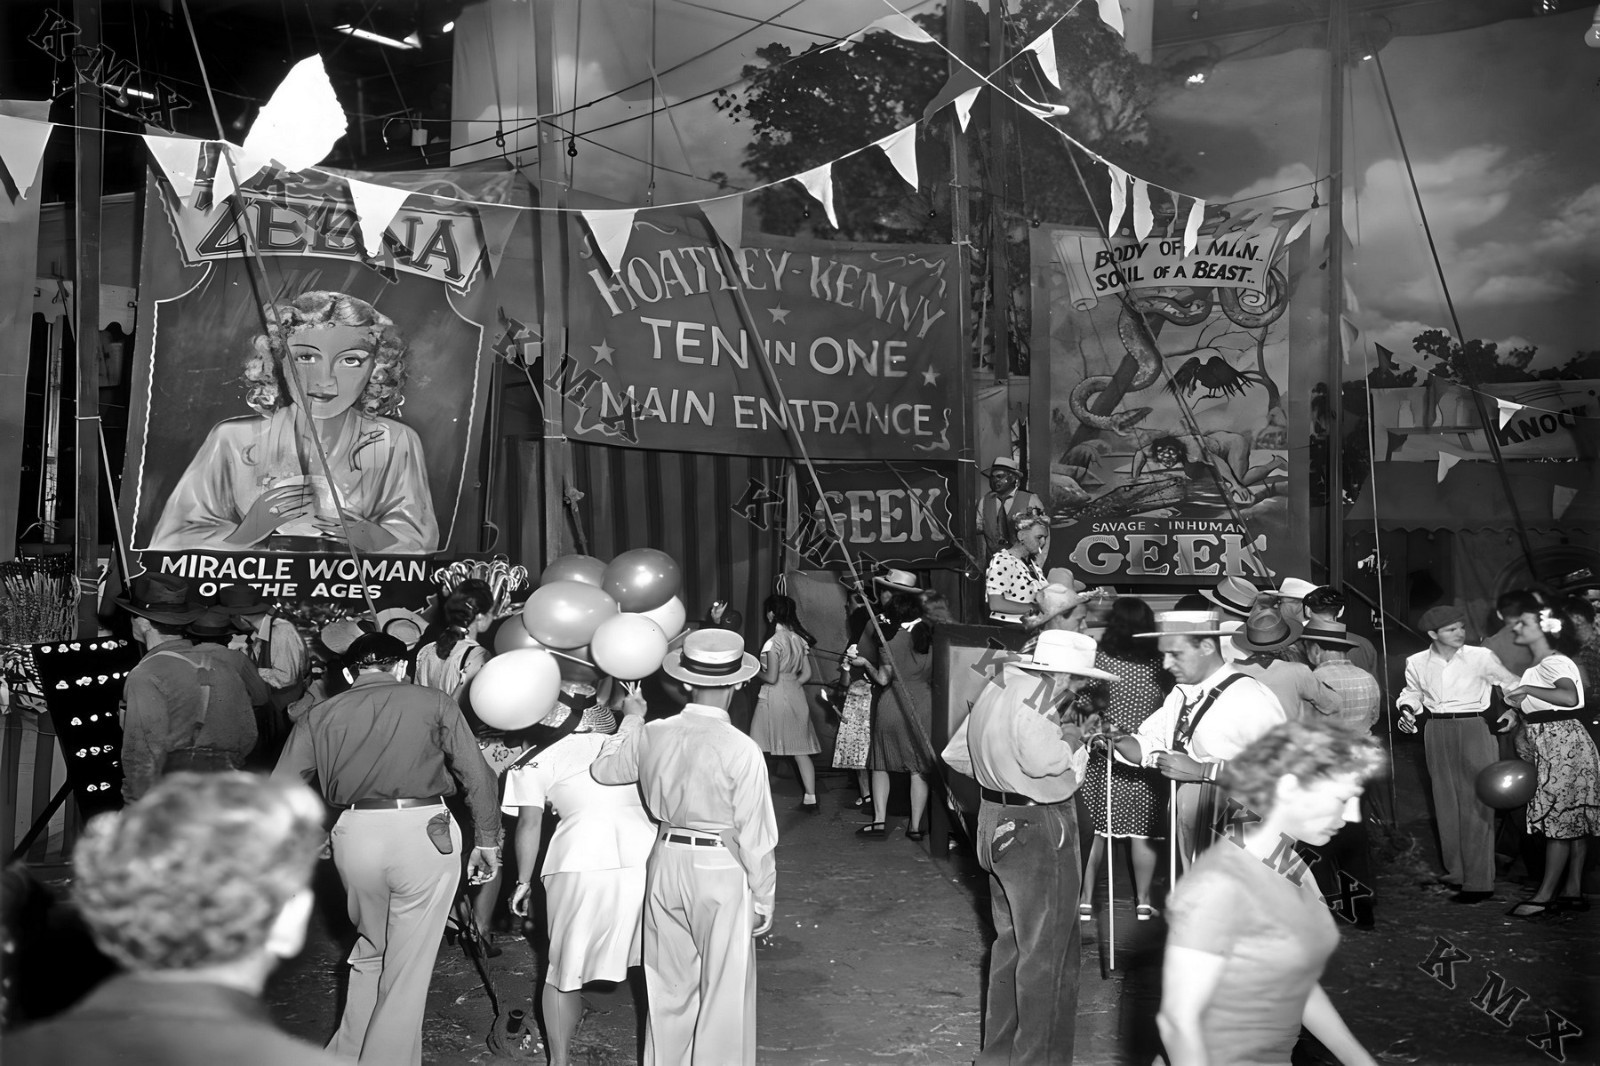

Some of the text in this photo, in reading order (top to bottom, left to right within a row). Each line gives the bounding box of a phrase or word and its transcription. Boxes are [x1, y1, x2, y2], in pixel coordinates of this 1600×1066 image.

[1093, 242, 1149, 271] BODY
[1159, 240, 1181, 256] OF
[588, 246, 946, 339] HOATLEY-KENNY
[1095, 265, 1144, 292] SOUL
[1153, 266, 1171, 279] OF
[1173, 265, 1187, 279] A
[641, 316, 908, 377] TEN IN ONE
[600, 381, 933, 436] MAIN ENTRANCE
[814, 488, 945, 543] GEEK
[1092, 520, 1247, 533] SAVAGE INHUMAN
[160, 554, 427, 582] MIRACLE WOMAN
[1069, 534, 1276, 577] GEEK
[199, 582, 235, 597] O
[310, 582, 382, 599] AGES
